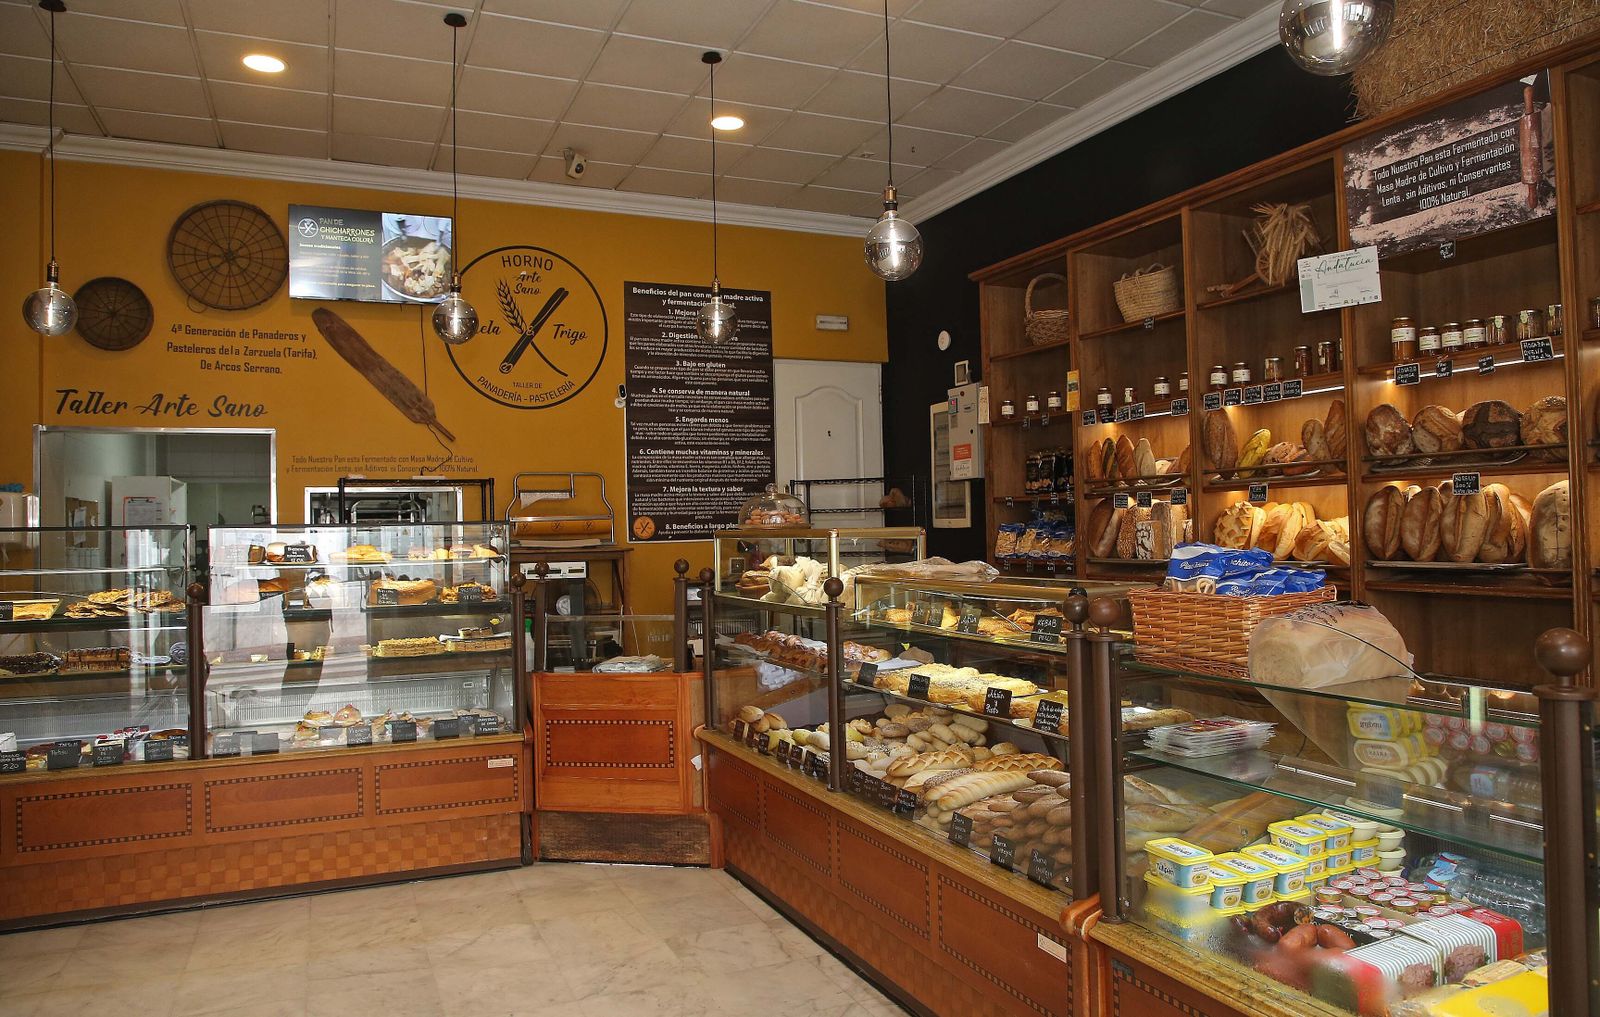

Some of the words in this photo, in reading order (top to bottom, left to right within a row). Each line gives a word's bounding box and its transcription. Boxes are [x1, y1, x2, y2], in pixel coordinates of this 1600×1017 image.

[1373, 169, 1390, 182] Todo
[1391, 161, 1419, 176] Nuestro
[1419, 154, 1434, 167] Pan
[1452, 134, 1499, 155] Fermentado
[1501, 127, 1516, 140] con
[1376, 182, 1394, 195] Masa
[1395, 175, 1417, 190] Madre
[1418, 170, 1427, 181] de
[1428, 163, 1454, 179] Cultivo
[1455, 161, 1460, 171] y
[1461, 143, 1515, 168] Fermentación
[1405, 188, 1417, 199] sin
[1449, 175, 1457, 186] ni
[1458, 160, 1511, 184] Conservantes
[1418, 195, 1440, 210] 100%
[1441, 186, 1471, 205] Natural.
[320, 226, 375, 237] CHICHARRONES
[502, 254, 554, 271] HORNO
[513, 271, 542, 283] Arte
[513, 283, 541, 295] Sano
[632, 286, 667, 296] Beneficios
[668, 287, 679, 296] del
[679, 289, 692, 299] pan
[693, 290, 705, 298] con
[723, 293, 744, 301] madre
[744, 294, 764, 302] activa
[674, 309, 696, 318] Mejora
[171, 323, 183, 334] 4ª
[185, 324, 236, 339] Generación
[239, 328, 250, 339] de
[252, 328, 299, 342] Panaderos
[300, 332, 307, 343] y
[553, 323, 588, 345] Trigo
[668, 331, 698, 340] Digestión
[167, 342, 216, 356] Pasteleros
[243, 346, 282, 358] Zarzuela
[200, 359, 213, 371] De
[215, 361, 241, 372] Arcos
[243, 362, 283, 374] Serrano.
[477, 376, 522, 403] PANADERÍA
[529, 380, 576, 403] PASTELERÍA
[512, 381, 532, 389] TALLER
[55, 389, 128, 416] Taller
[134, 393, 200, 417] Arte
[207, 394, 268, 418] Sano
[308, 455, 332, 463] Nuestro
[334, 455, 346, 463] Pan
[361, 455, 396, 463] Fermentado
[700, 448, 730, 456] vitaminas
[670, 486, 691, 494] Mejora
[709, 523, 725, 531] largo
